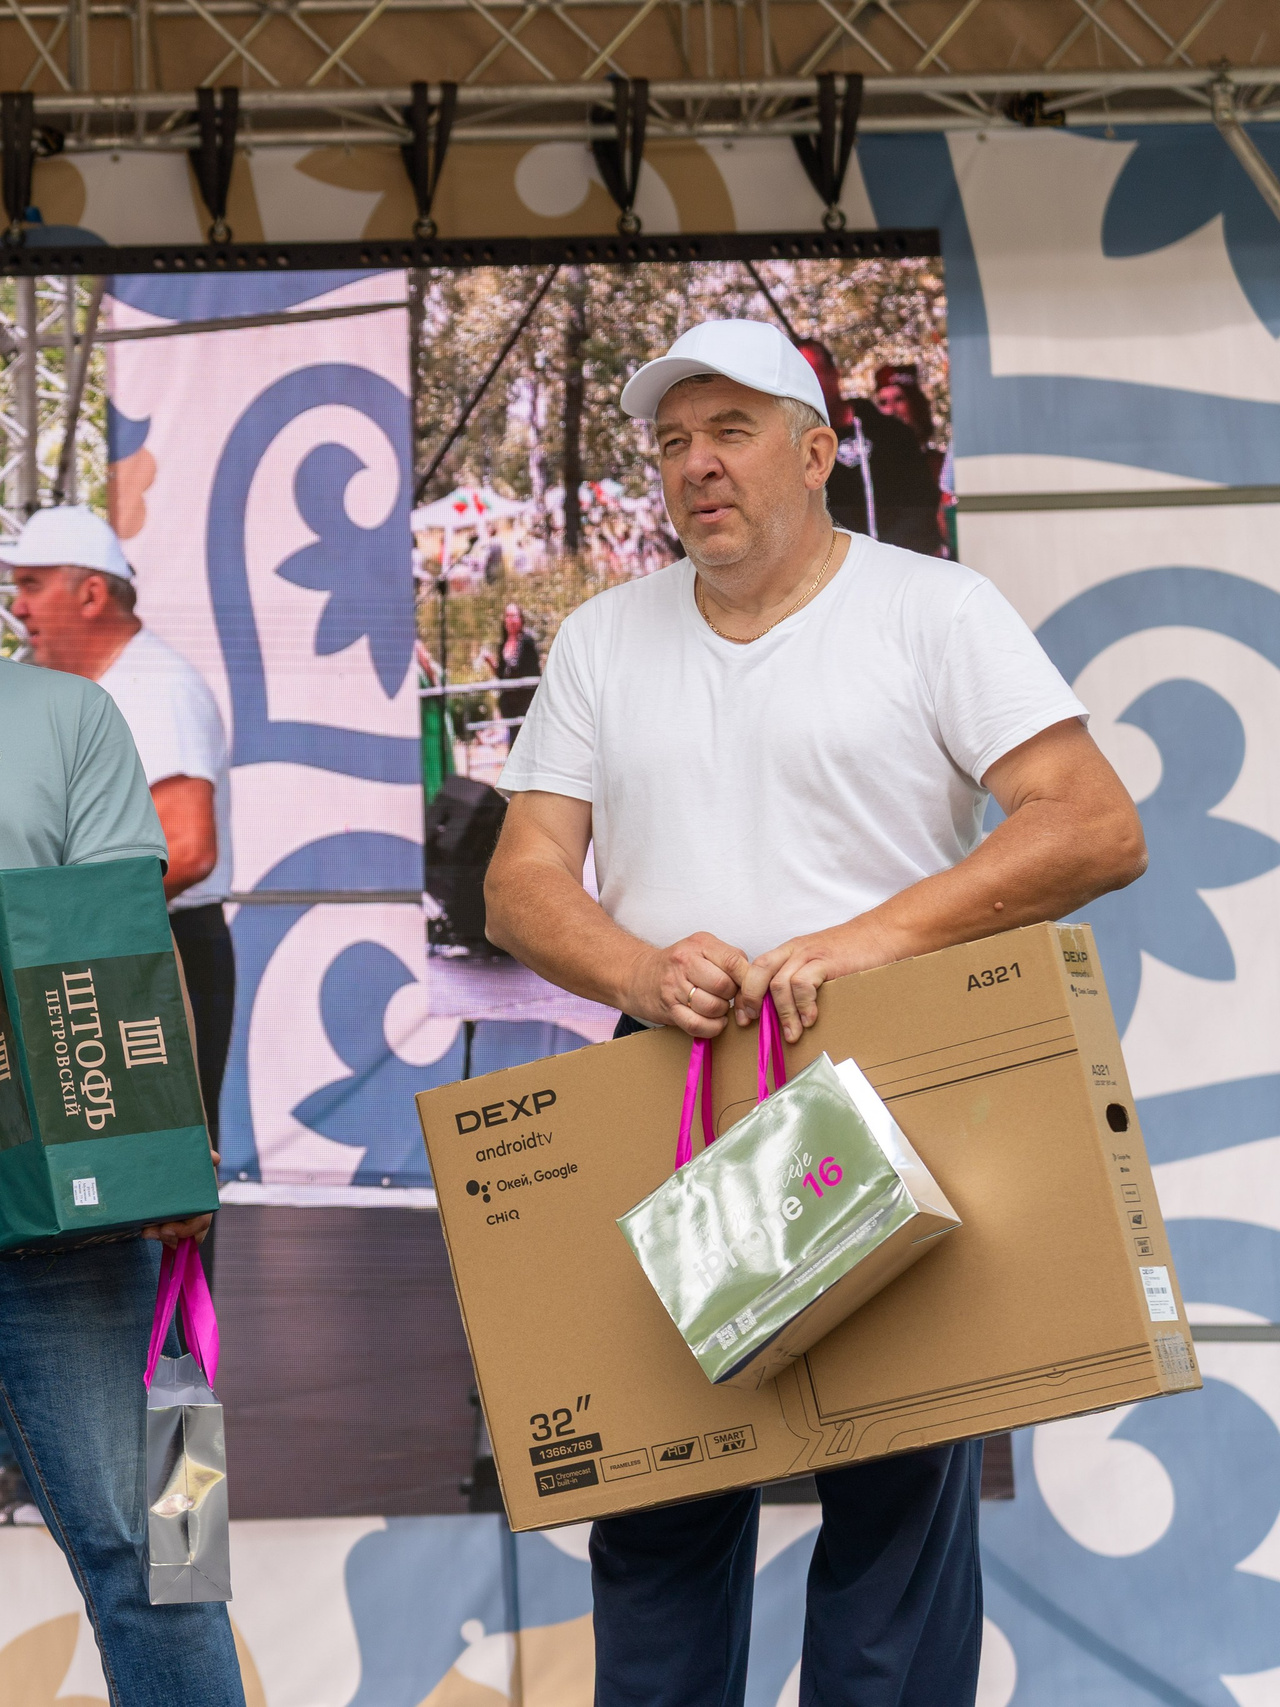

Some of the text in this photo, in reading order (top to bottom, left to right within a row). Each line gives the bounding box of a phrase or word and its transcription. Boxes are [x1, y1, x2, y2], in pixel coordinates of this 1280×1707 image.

[1062, 950, 1088, 963] DEXP
[966, 962, 1022, 992] A321
[61, 968, 116, 1131] ШТОФЪ
[1091, 1064, 1110, 1076] A321
[454, 1089, 557, 1135] DEXP
[496, 1162, 578, 1192] Окей, Google
[486, 1209, 520, 1226] CHiQ
[692, 1196, 803, 1291] iPhone
[802, 1156, 843, 1199] 16
[713, 1430, 745, 1445] SMART
[725, 1440, 745, 1450] TV
[539, 1440, 593, 1460] 1366x768
[666, 1444, 688, 1457] HD
[609, 1459, 641, 1471] FRAMELESS
[555, 1467, 592, 1481] Chromecast
[557, 1477, 578, 1487] built-in
